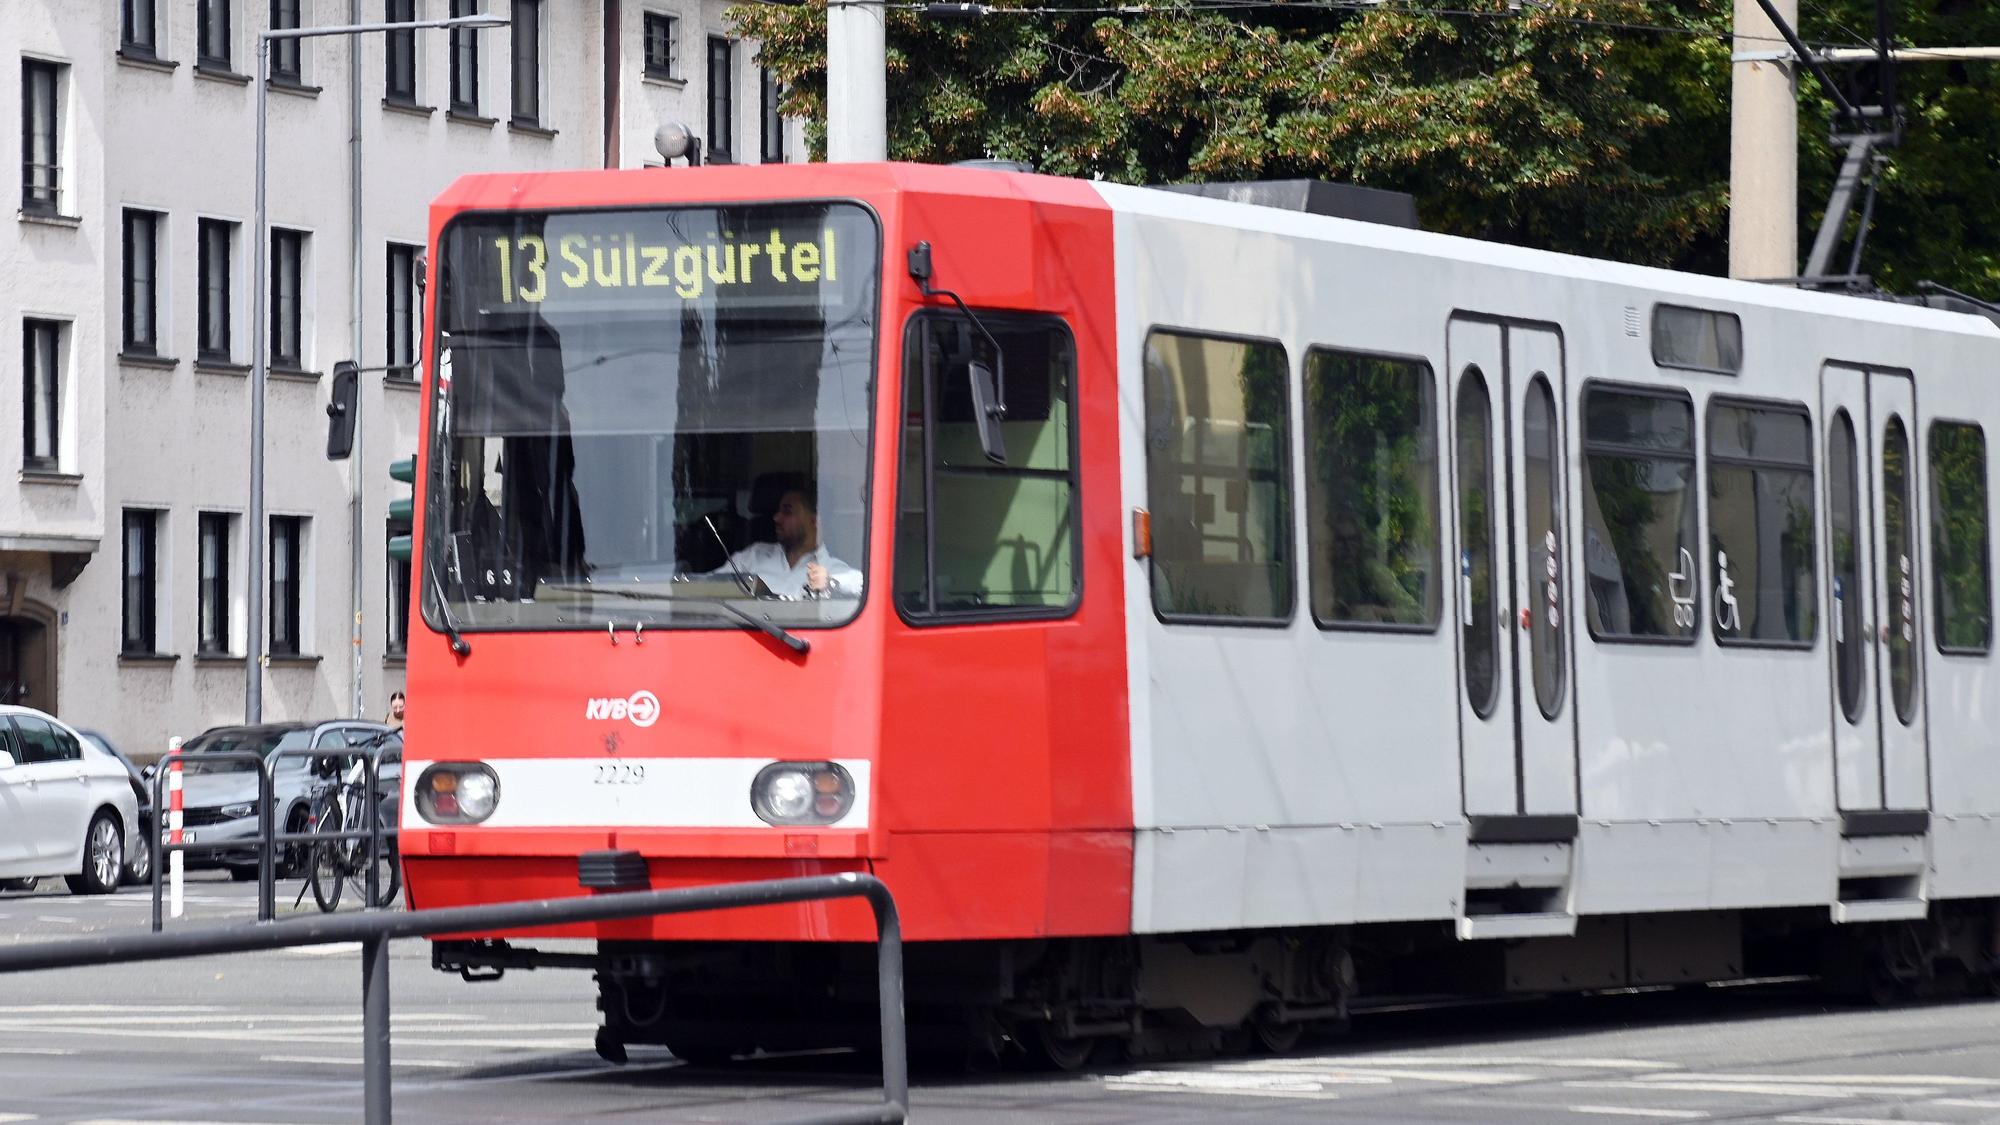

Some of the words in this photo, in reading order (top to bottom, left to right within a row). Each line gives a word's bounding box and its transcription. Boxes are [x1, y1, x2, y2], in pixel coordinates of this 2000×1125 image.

[495, 234, 547, 304] 13
[560, 228, 836, 299] Sülzgürtel
[585, 697, 628, 721] KVB
[594, 764, 645, 785] 2229
